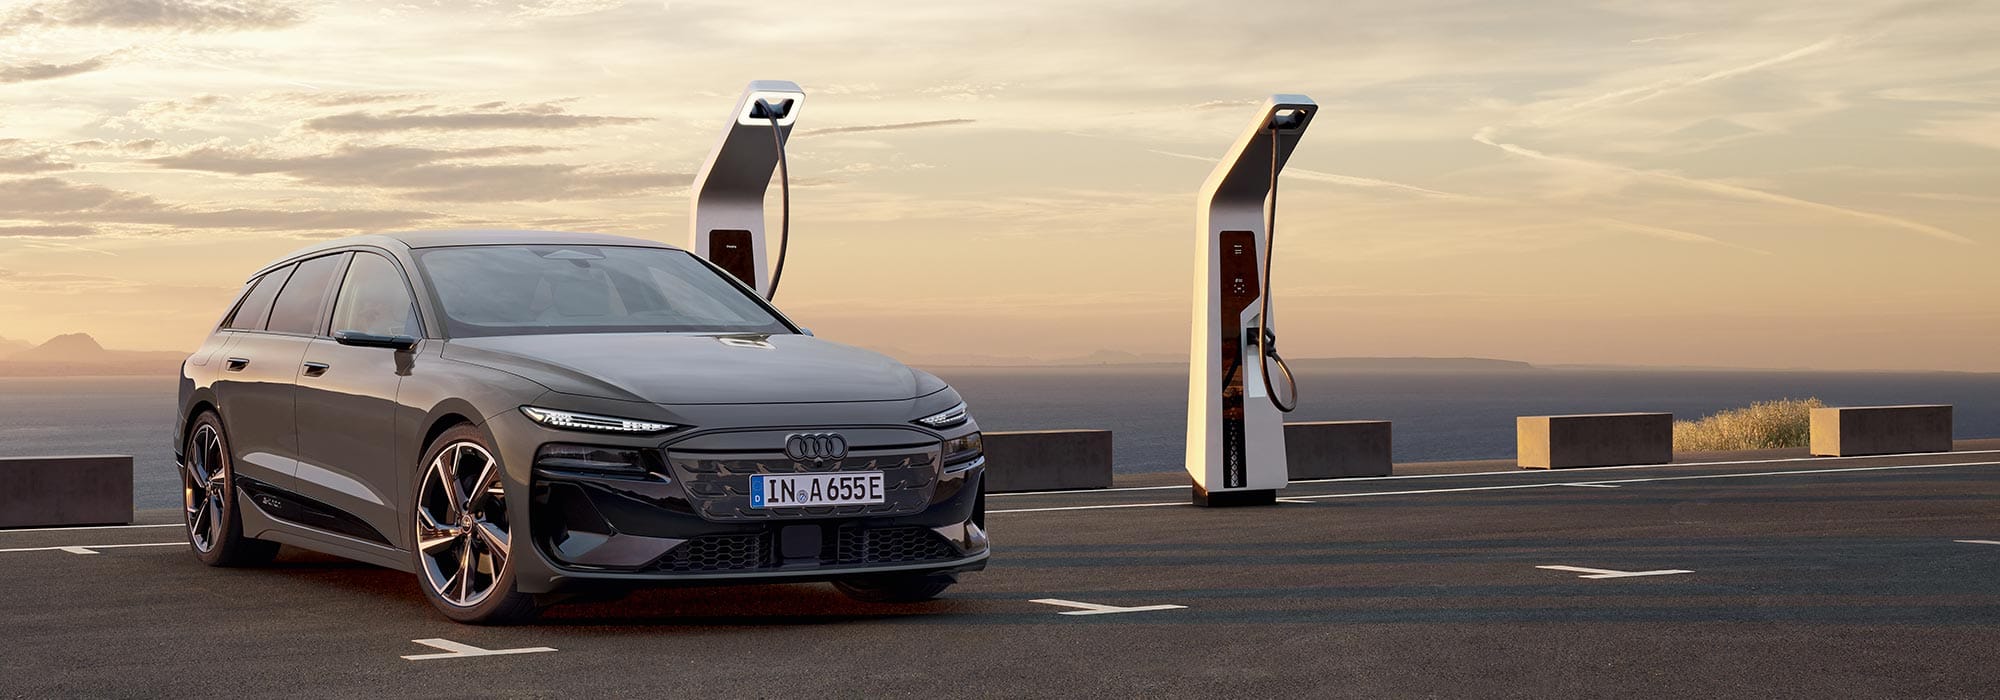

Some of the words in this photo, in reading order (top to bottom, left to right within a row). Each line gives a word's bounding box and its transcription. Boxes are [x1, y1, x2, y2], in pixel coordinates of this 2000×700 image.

[768, 479, 795, 503] IN
[810, 478, 823, 501] A
[754, 495, 761, 503] D
